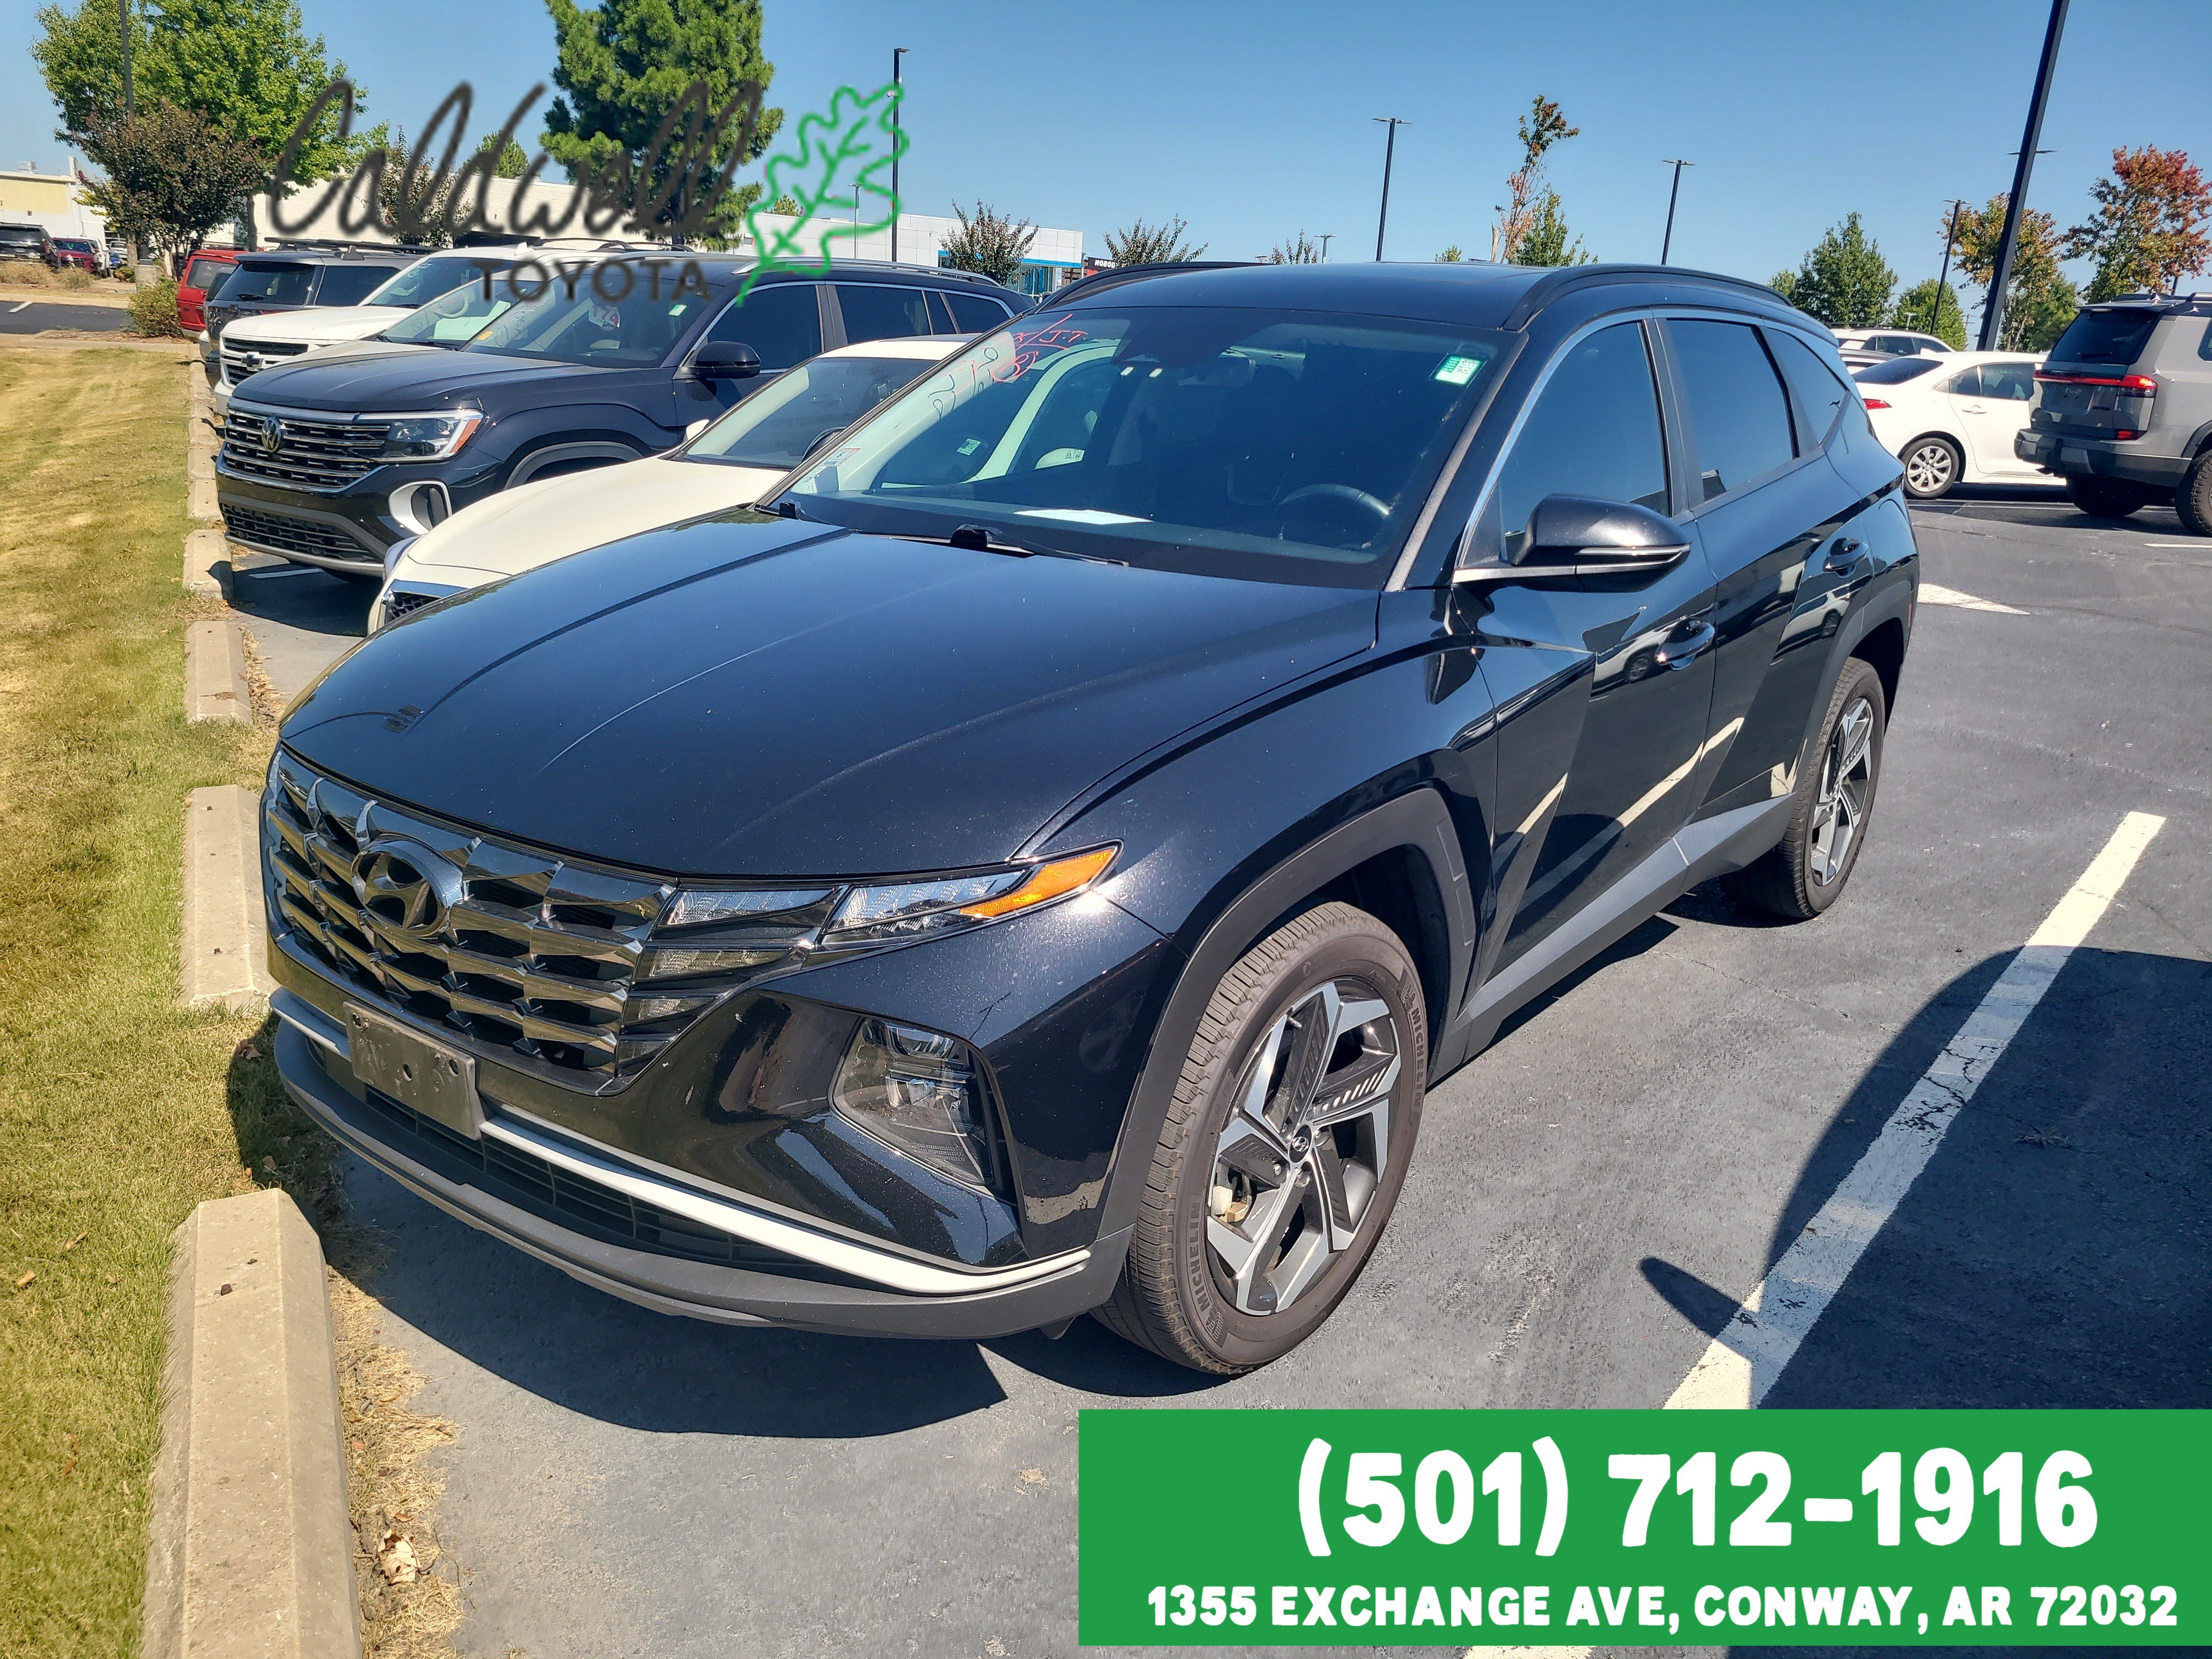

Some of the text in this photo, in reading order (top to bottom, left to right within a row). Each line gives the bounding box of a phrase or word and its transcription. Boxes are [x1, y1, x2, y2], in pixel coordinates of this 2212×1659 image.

[1094, 259, 1120, 269] NOBOD
[1411, 1007, 1425, 1107] MICHELIN
[1189, 1201, 1211, 1312] MICHELIN
